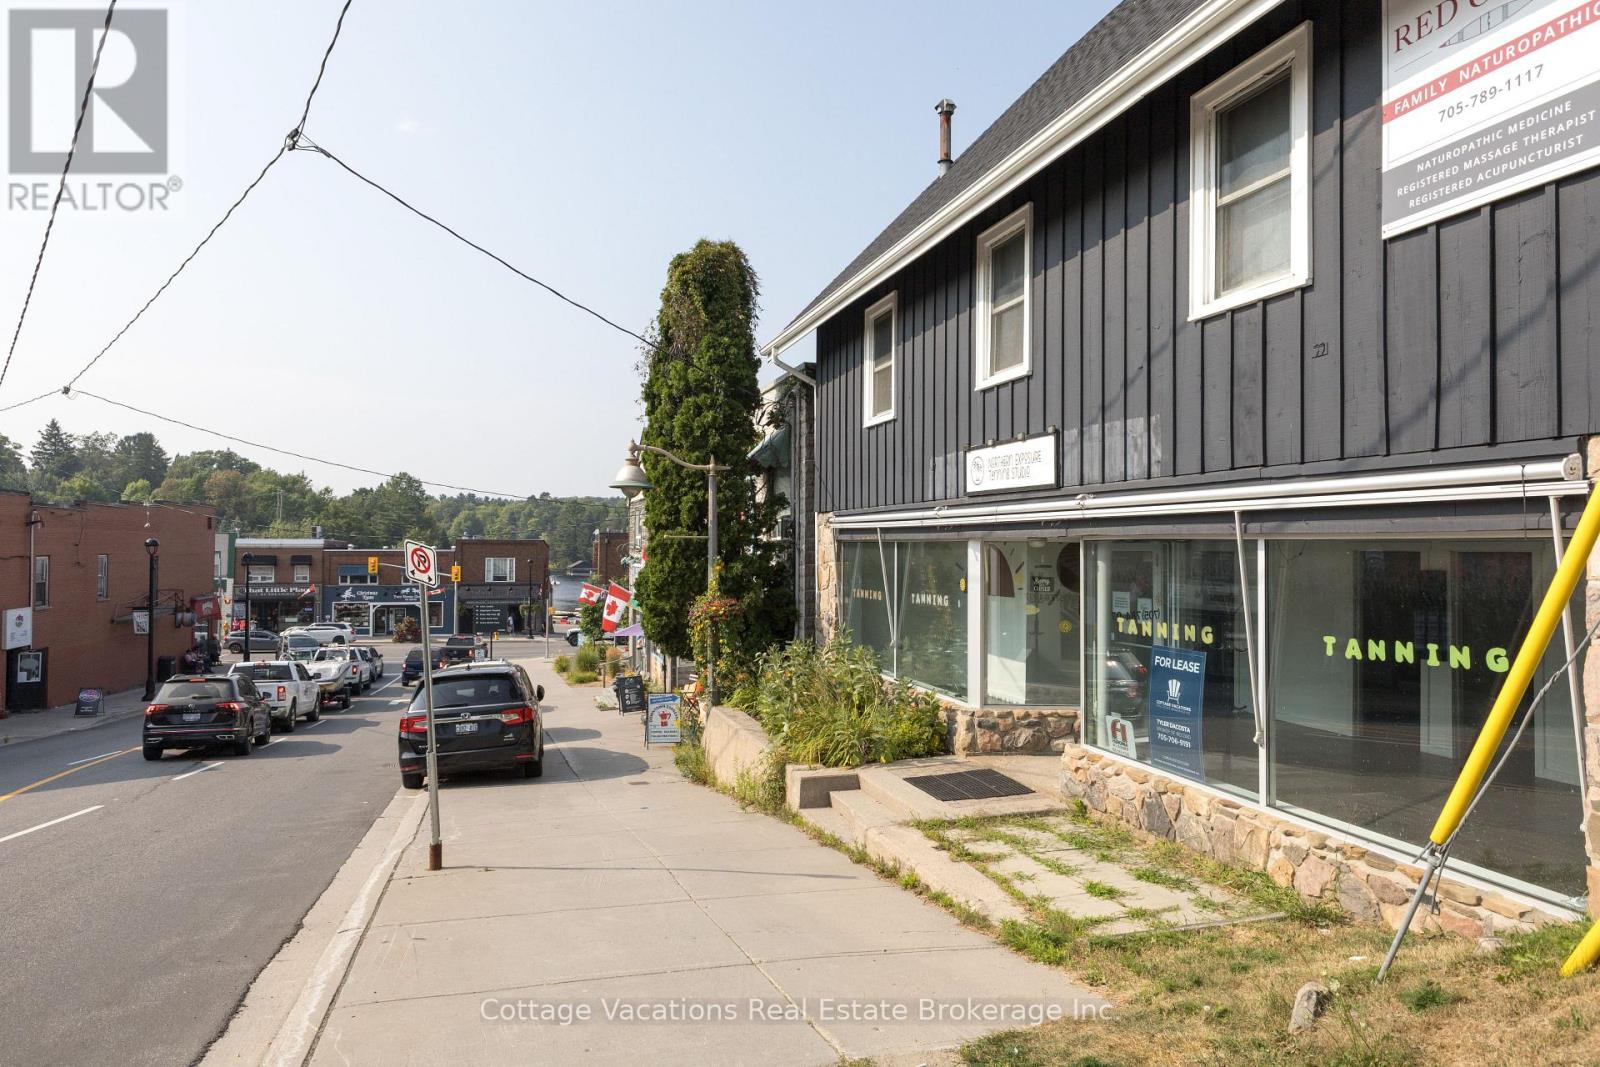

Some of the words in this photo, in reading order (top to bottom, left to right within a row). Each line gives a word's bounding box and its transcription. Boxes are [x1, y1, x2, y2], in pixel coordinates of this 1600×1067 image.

[1394, 0, 1458, 53] RED
[1394, 79, 1448, 114] FAMILY
[1459, 1, 1600, 83] NATUROPATHIC
[1438, 64, 1544, 123] 705-789-1117
[1397, 165, 1459, 197] REGISTERED
[1463, 141, 1518, 171] MASSAGE
[1523, 110, 1596, 147] THERAPIST
[1416, 129, 1503, 173] NATUROPATHIC
[1508, 100, 1572, 136] MEDICINE
[1409, 177, 1472, 209] REGISTERED
[1476, 134, 1584, 183] ACUPUNCTURIST
[853, 588, 882, 601] TANNING
[911, 593, 949, 607] TANNING
[1116, 617, 1214, 645] TANNING
[1154, 656, 1171, 668] FOR
[1172, 659, 1200, 674] LEASE
[1323, 635, 1509, 673] TANNING
[1156, 718, 1170, 728] TYLER
[1170, 722, 1191, 733] DACOSTA
